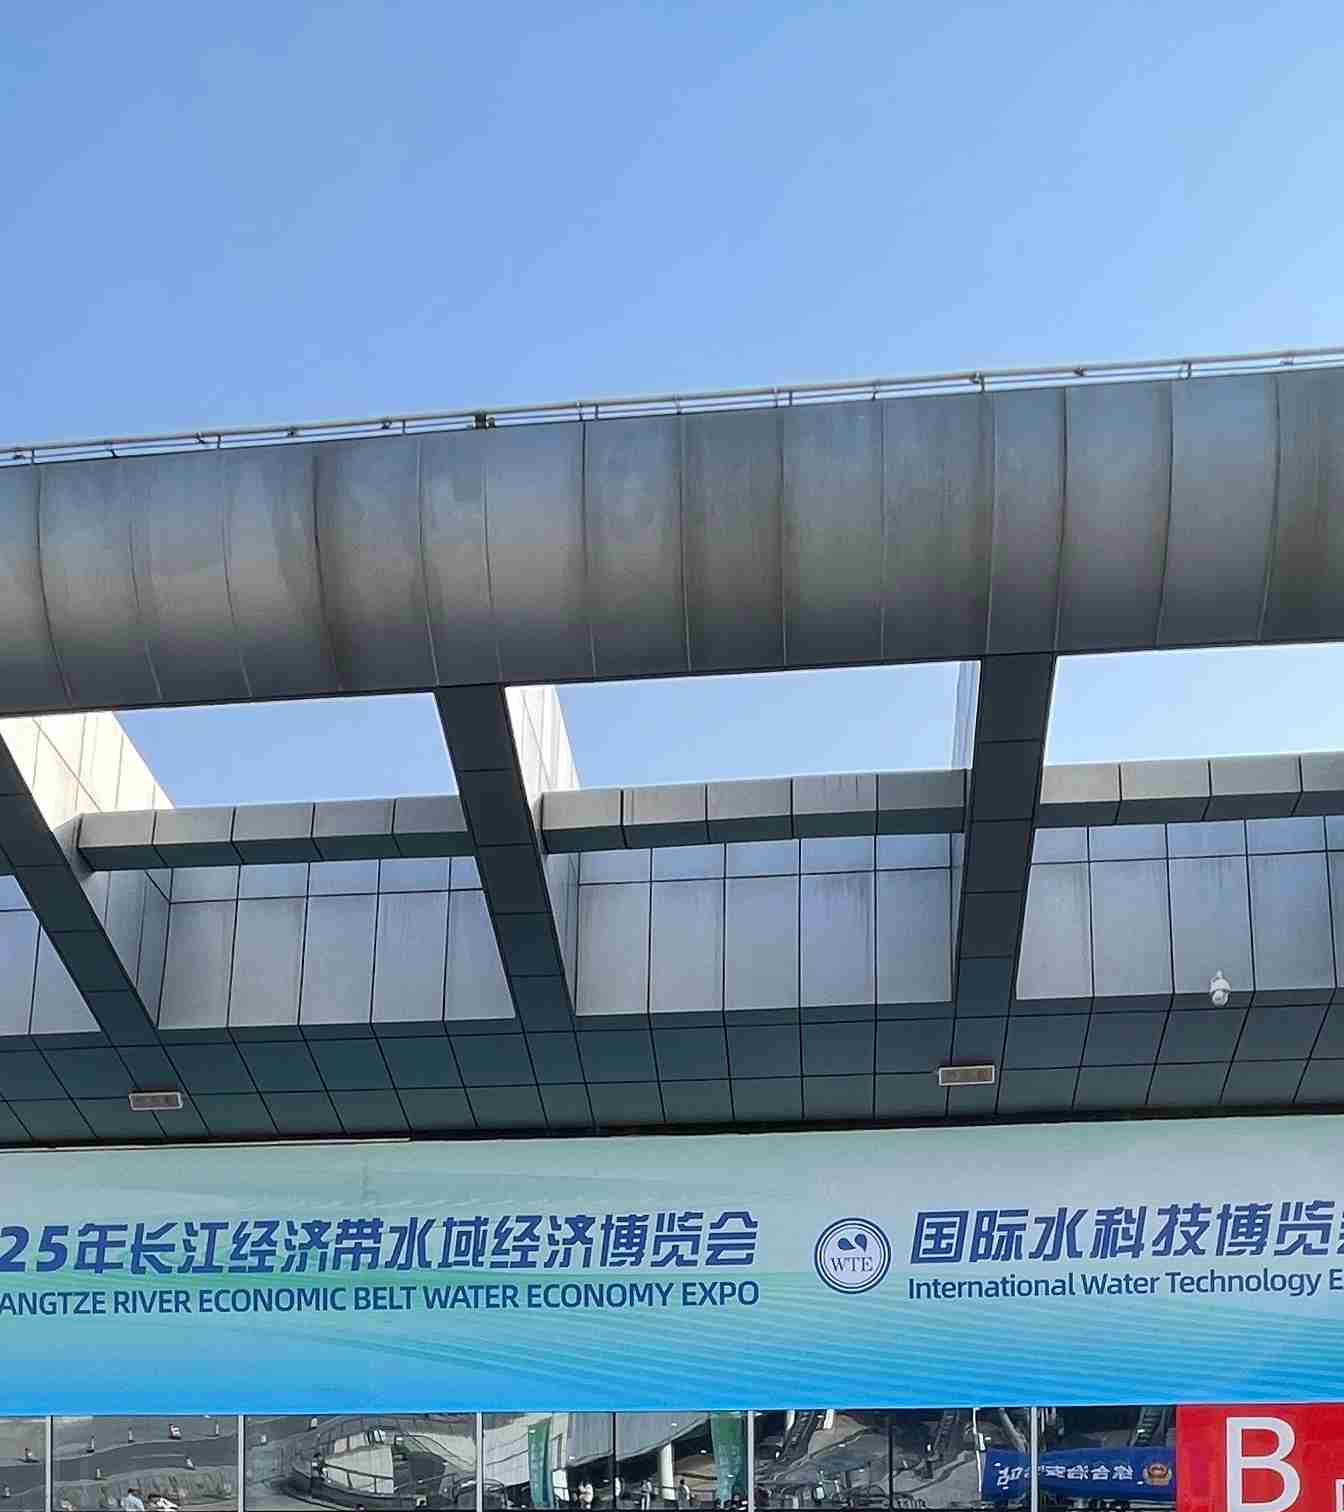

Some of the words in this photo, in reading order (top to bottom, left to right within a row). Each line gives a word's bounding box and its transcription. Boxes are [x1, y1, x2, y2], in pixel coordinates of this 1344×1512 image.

[830, 1256, 873, 1273] WTE
[114, 1290, 193, 1314] RIVER
[199, 1287, 347, 1313] ECONOMIC
[354, 1286, 417, 1311] BELT
[423, 1284, 520, 1310] WATER
[527, 1283, 675, 1309] ECONOMY
[683, 1281, 760, 1307] EXPO
[908, 1272, 1076, 1300] International
[1081, 1272, 1160, 1296] Water
[1165, 1268, 1322, 1297] Technology
